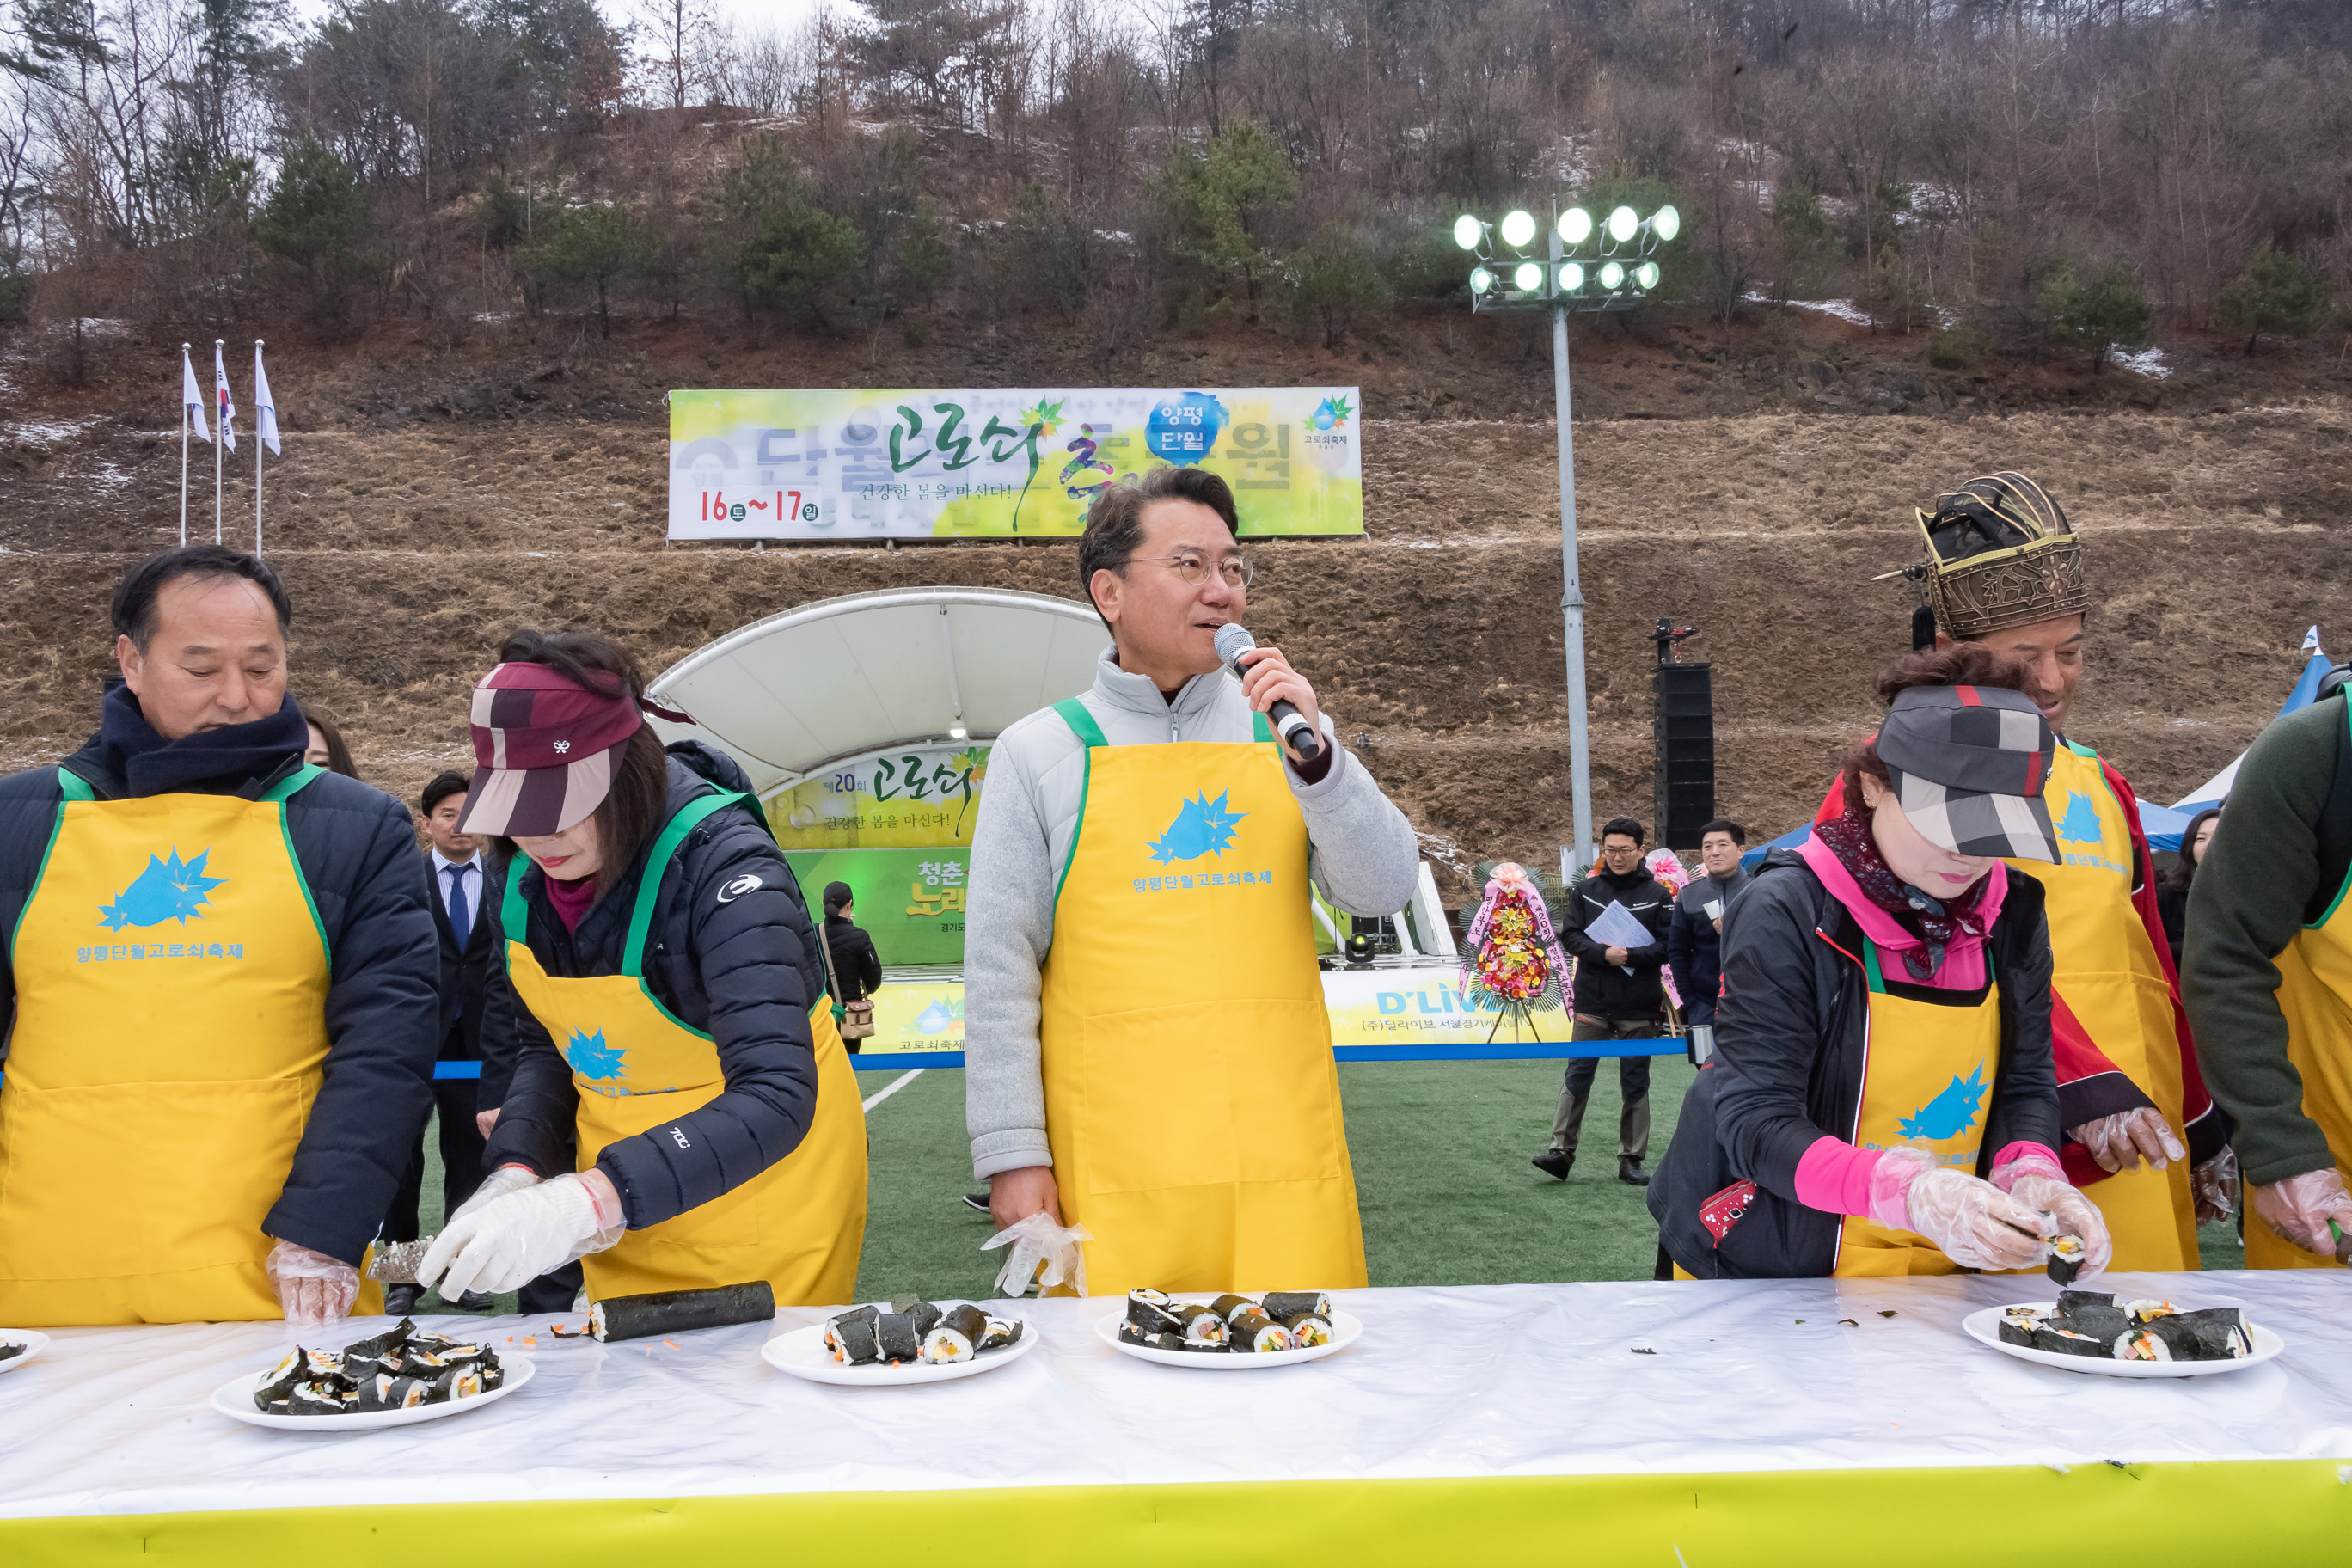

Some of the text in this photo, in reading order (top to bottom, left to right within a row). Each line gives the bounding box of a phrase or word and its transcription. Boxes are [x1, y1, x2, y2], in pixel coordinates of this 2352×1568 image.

[1161, 407, 1203, 426] 양평
[1161, 432, 1203, 450] 단월
[1304, 435, 1348, 444] 고로쇠축제
[860, 483, 1012, 501] 건강한 봄을 마신다!
[823, 773, 867, 793] 제20회
[825, 812, 950, 830] 건강한 봄을 마신다!
[918, 861, 965, 886] 청춘
[1133, 870, 1272, 893] 양평단월고로쇠축제
[77, 943, 244, 963] 양평단월고로쇠축제
[1362, 1019, 1436, 1031] (주)딜라이브
[899, 1039, 965, 1050] 고로쇠축제
